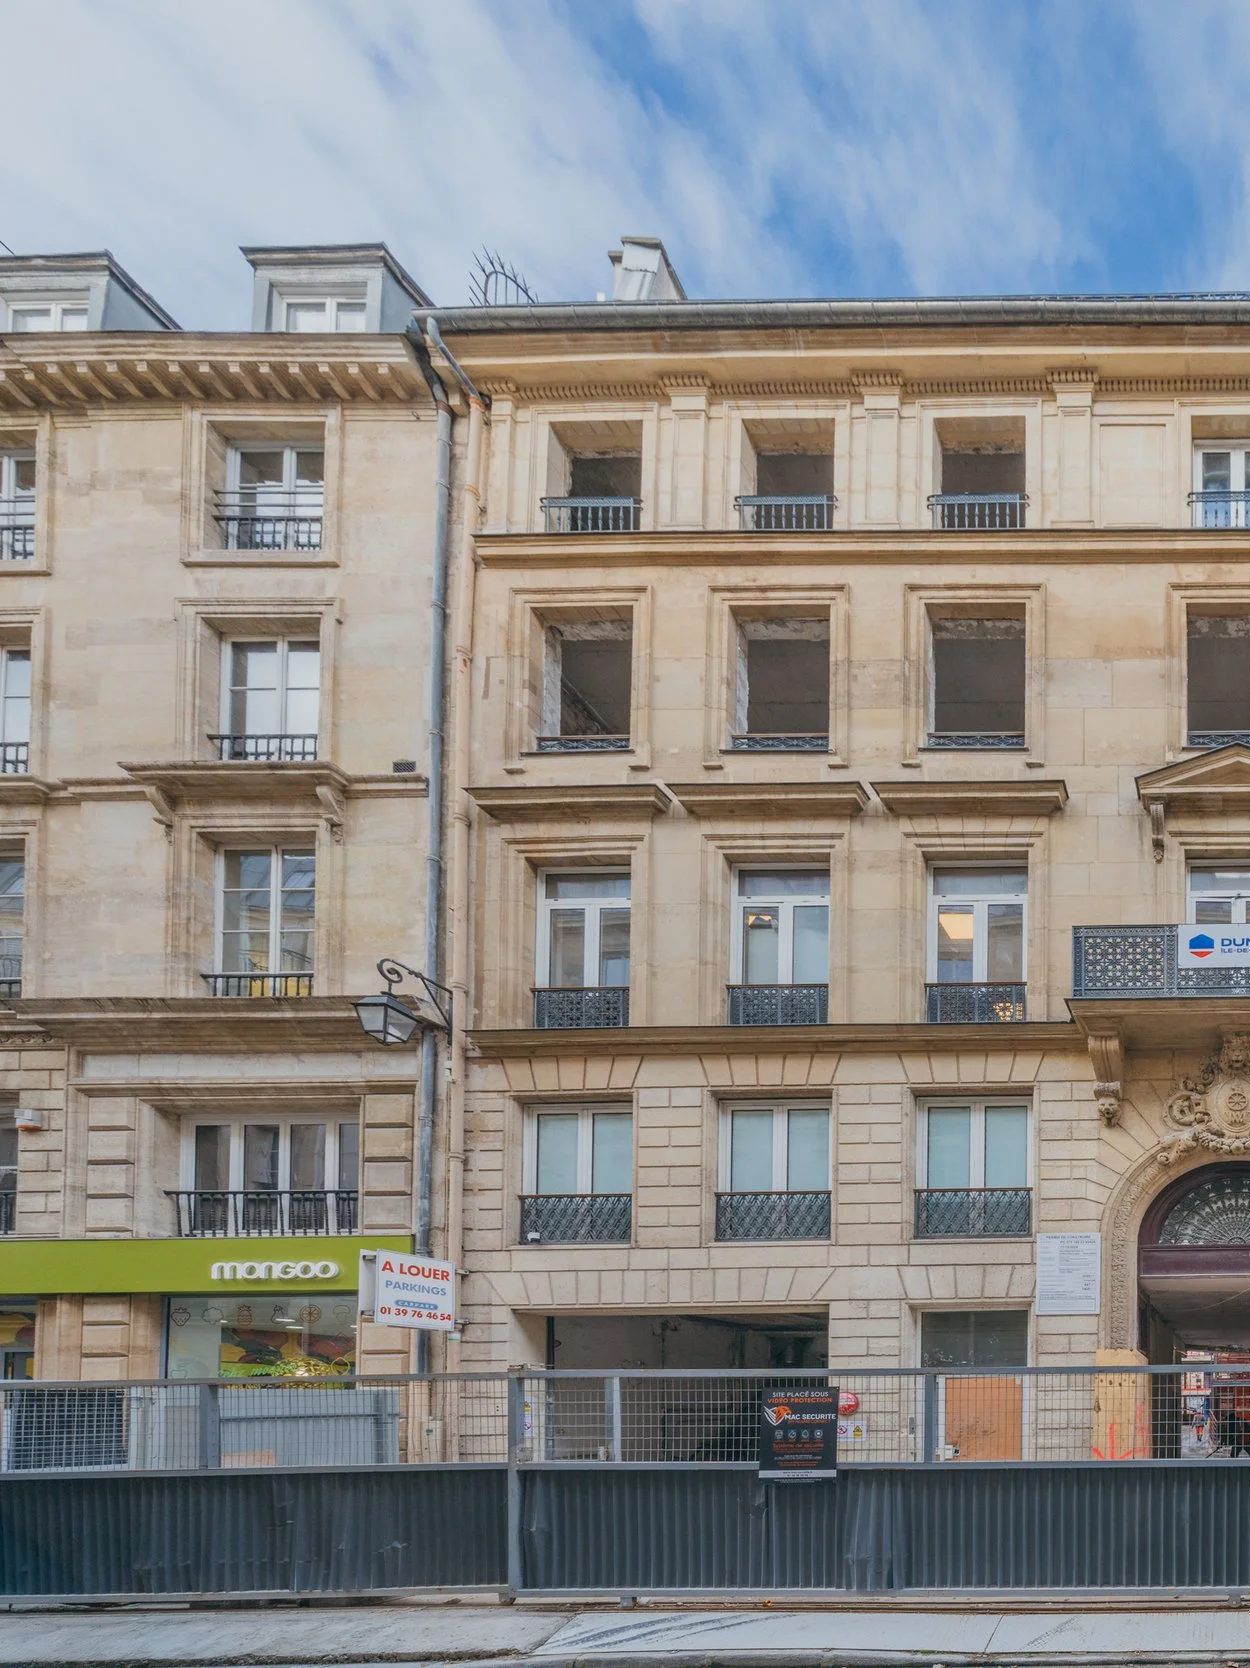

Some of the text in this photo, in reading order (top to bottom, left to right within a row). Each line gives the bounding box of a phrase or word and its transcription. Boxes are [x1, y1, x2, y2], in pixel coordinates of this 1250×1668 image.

[381, 1260, 450, 1282] A LOUER
[385, 1280, 447, 1296] PARKINGS
[397, 1301, 436, 1309] CARPARK
[380, 1306, 451, 1321] 01 39 76 46 54
[787, 1390, 809, 1398] PLACÉ
